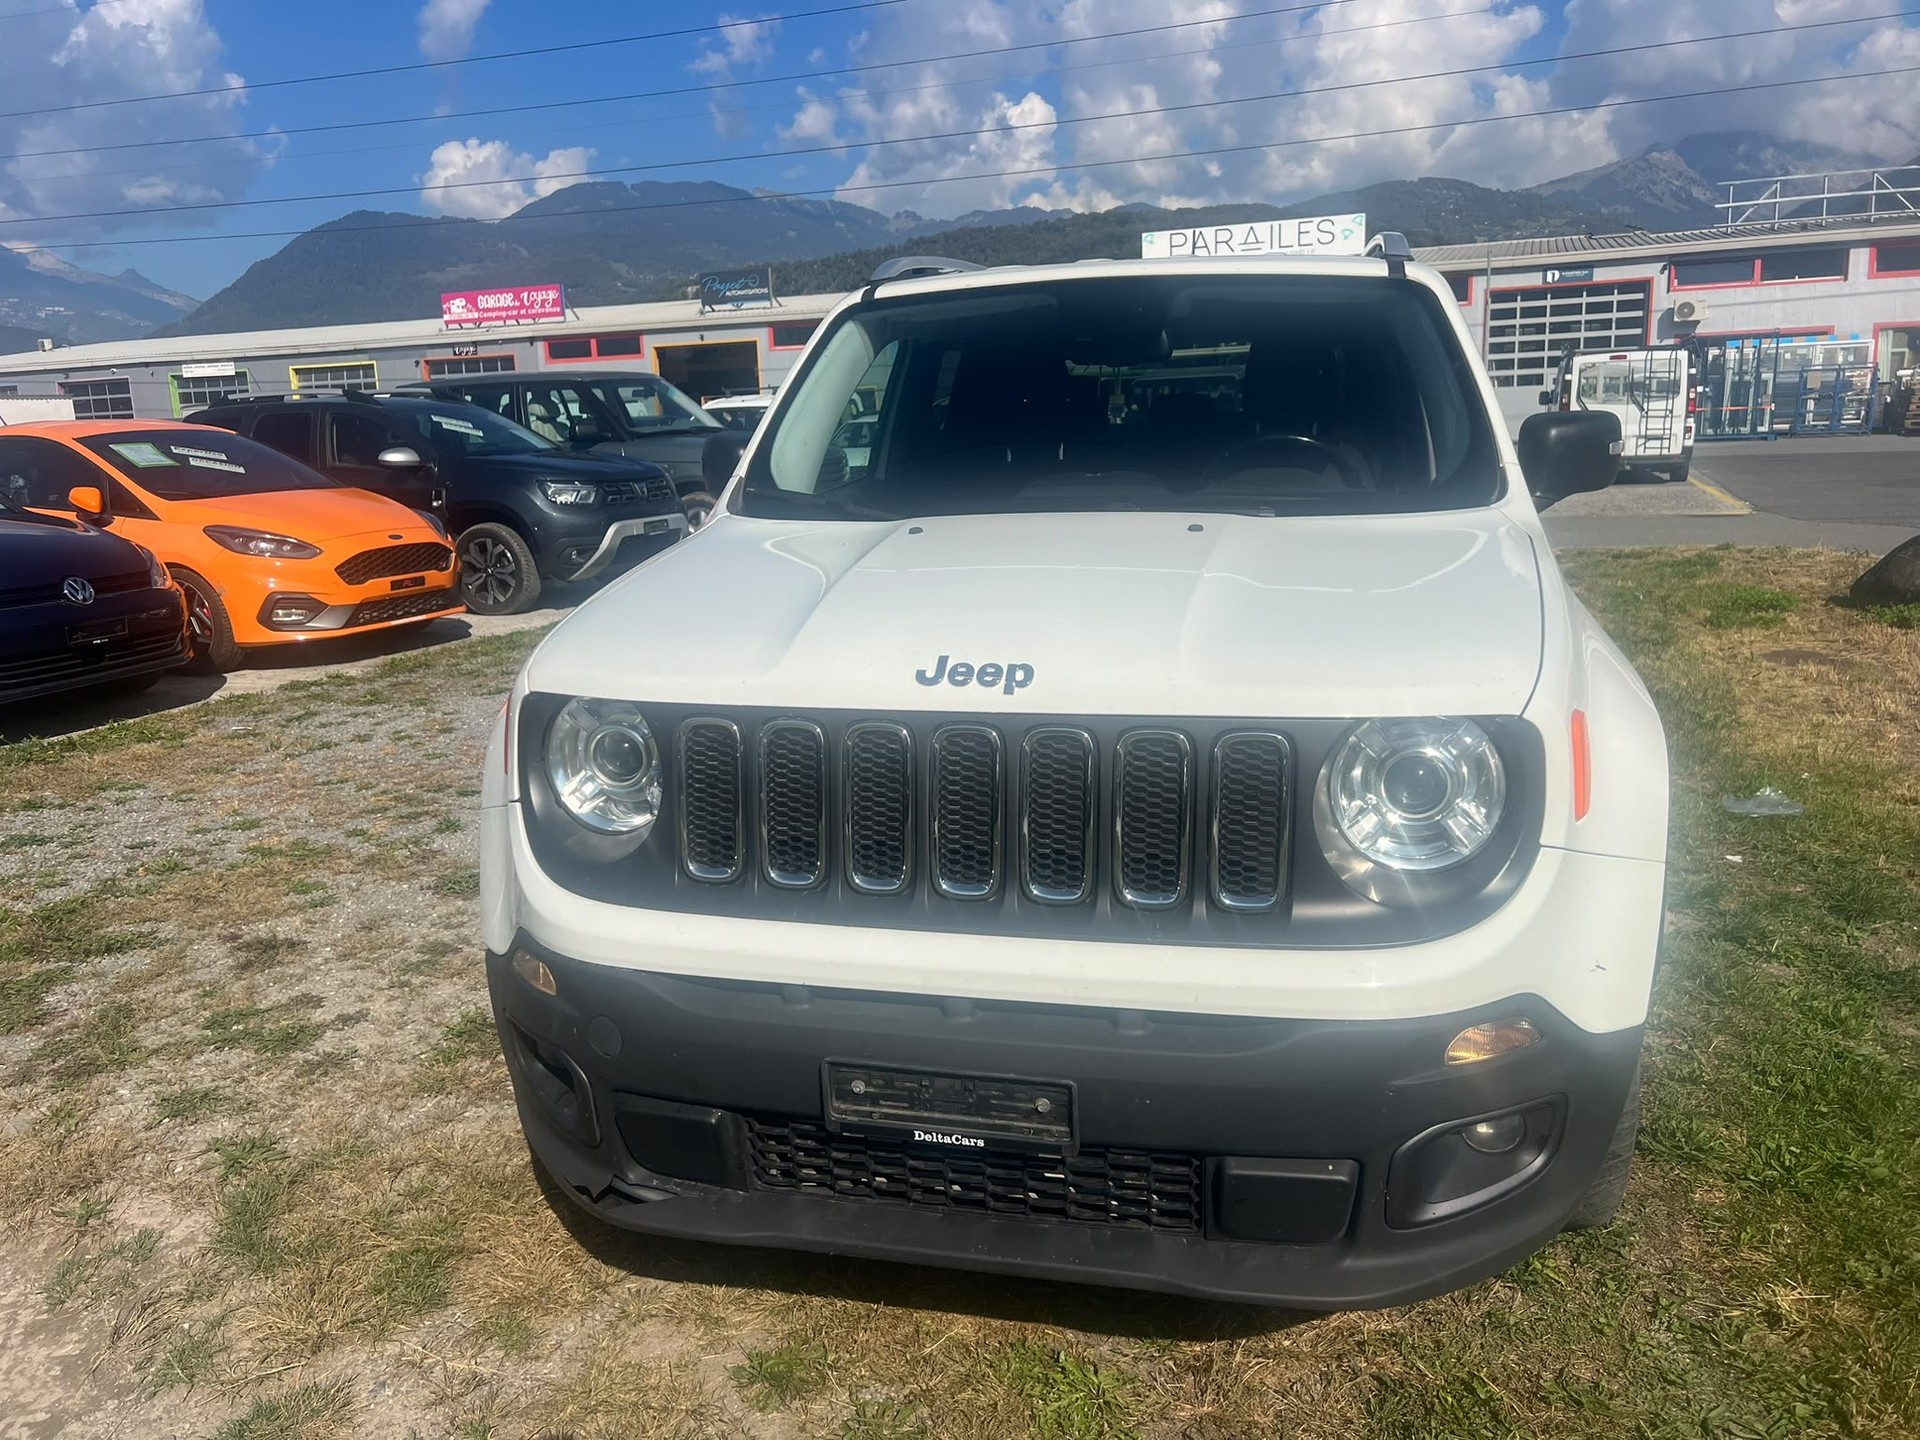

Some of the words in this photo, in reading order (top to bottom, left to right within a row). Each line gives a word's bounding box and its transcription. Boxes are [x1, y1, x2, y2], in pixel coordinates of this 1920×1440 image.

[702, 275, 746, 299] Payot
[477, 292, 514, 309] GARAGE
[520, 289, 560, 309] Voyage
[479, 309, 518, 319] Camping-car
[915, 655, 1035, 695] Jeep
[913, 1130, 985, 1147] DeltaCars
